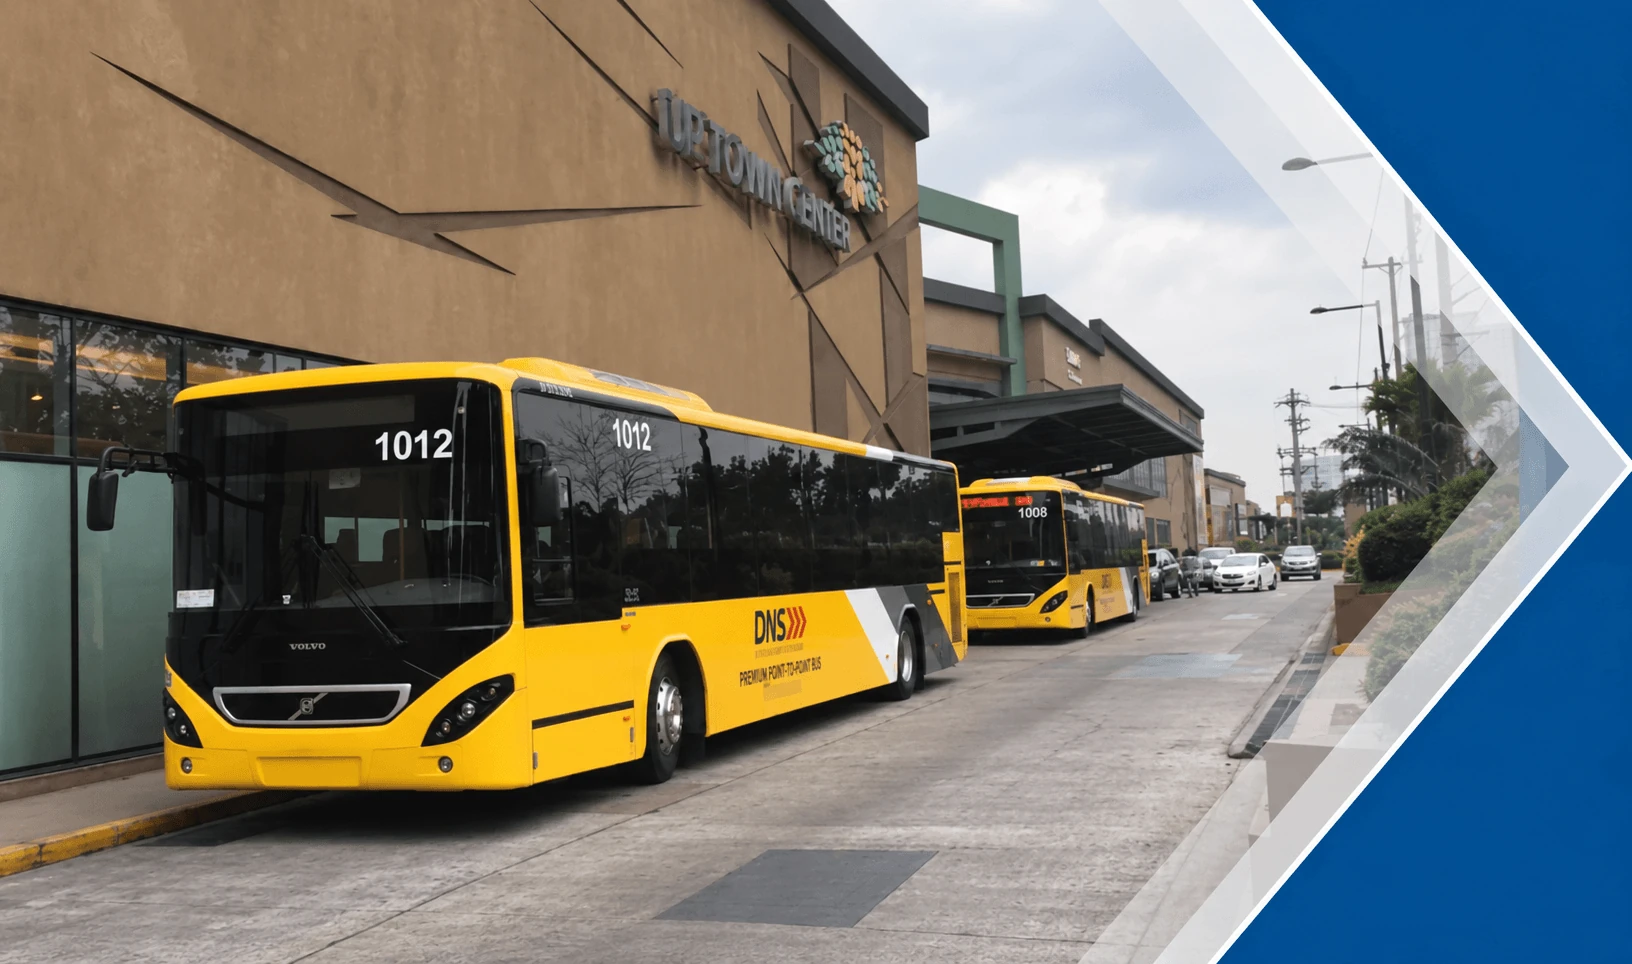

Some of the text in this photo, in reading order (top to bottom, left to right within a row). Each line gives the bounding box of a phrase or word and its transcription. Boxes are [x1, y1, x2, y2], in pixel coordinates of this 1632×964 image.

[703, 118, 782, 212] TOWN
[782, 176, 851, 253] CENTER
[375, 428, 452, 460] 1012
[612, 418, 652, 452] 1012
[1018, 506, 1048, 519] 1008
[755, 608, 786, 645] DNS
[289, 642, 327, 651] VOLVO
[739, 656, 821, 687] PREMIUM POINT-TO-POINT BUS
